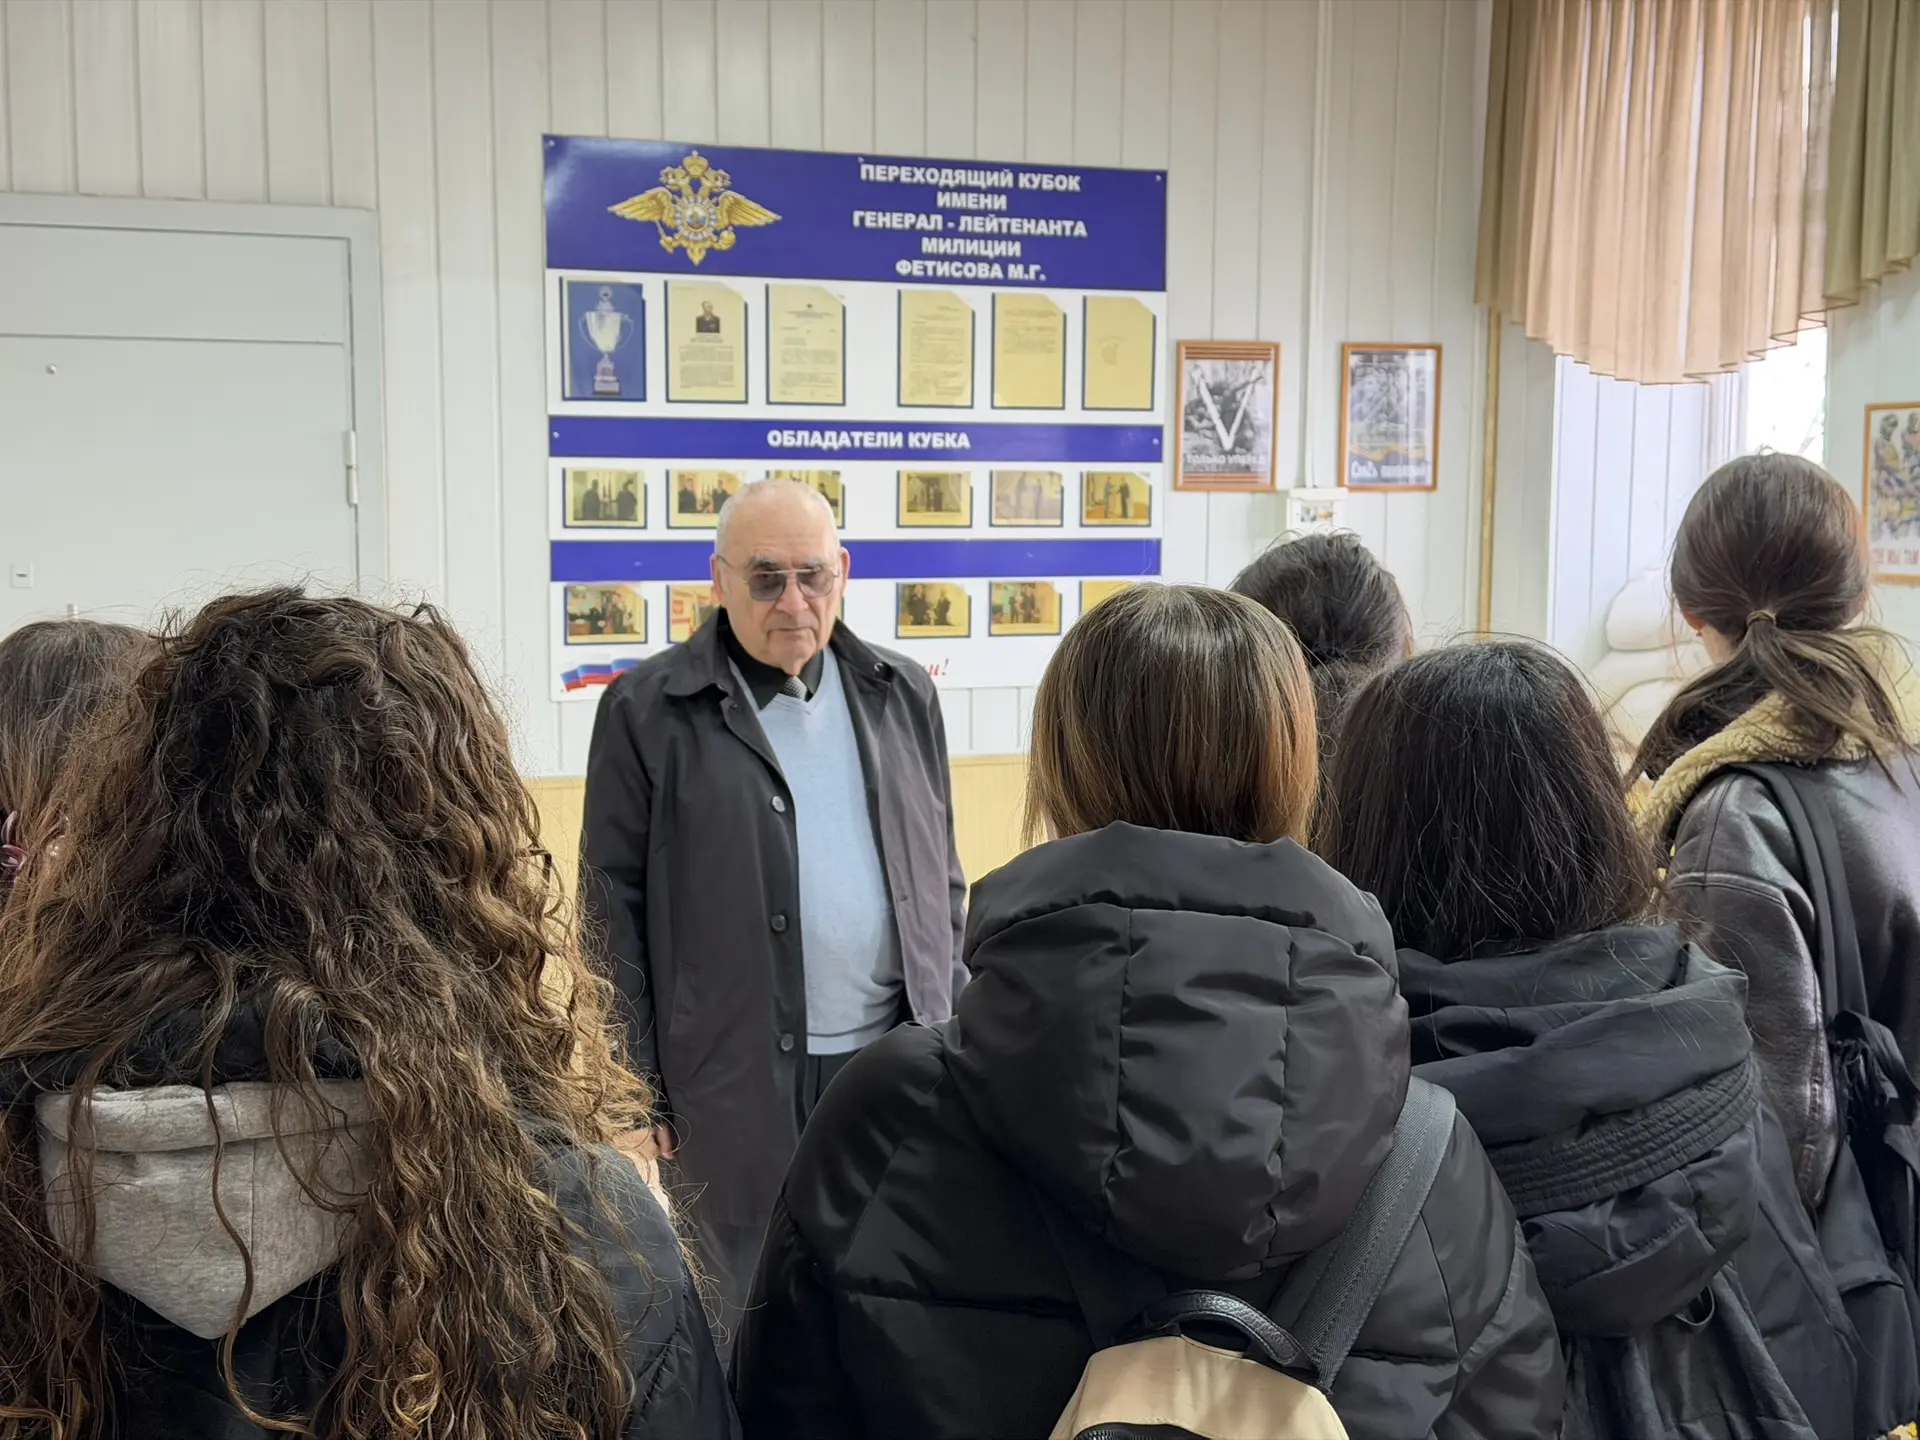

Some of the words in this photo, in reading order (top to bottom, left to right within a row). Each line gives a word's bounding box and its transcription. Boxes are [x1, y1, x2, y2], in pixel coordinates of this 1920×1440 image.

[860, 164, 1013, 190] ПЕРЕХОДЯЩИЙ
[1018, 172, 1081, 192] КУБОК
[936, 191, 1008, 211] ИМЕНИ
[852, 211, 943, 231] ГЕНЕРАЛ
[958, 214, 1088, 237] ЛЕЙТЕНАНТА
[921, 237, 1022, 259] МИЛИЦИИ
[895, 259, 1004, 280] ФЕТИСОВА
[1007, 263, 1047, 281] М.Г.
[766, 429, 903, 451] ОБЛАДАТЕЛИ
[907, 432, 971, 450] КУБКА
